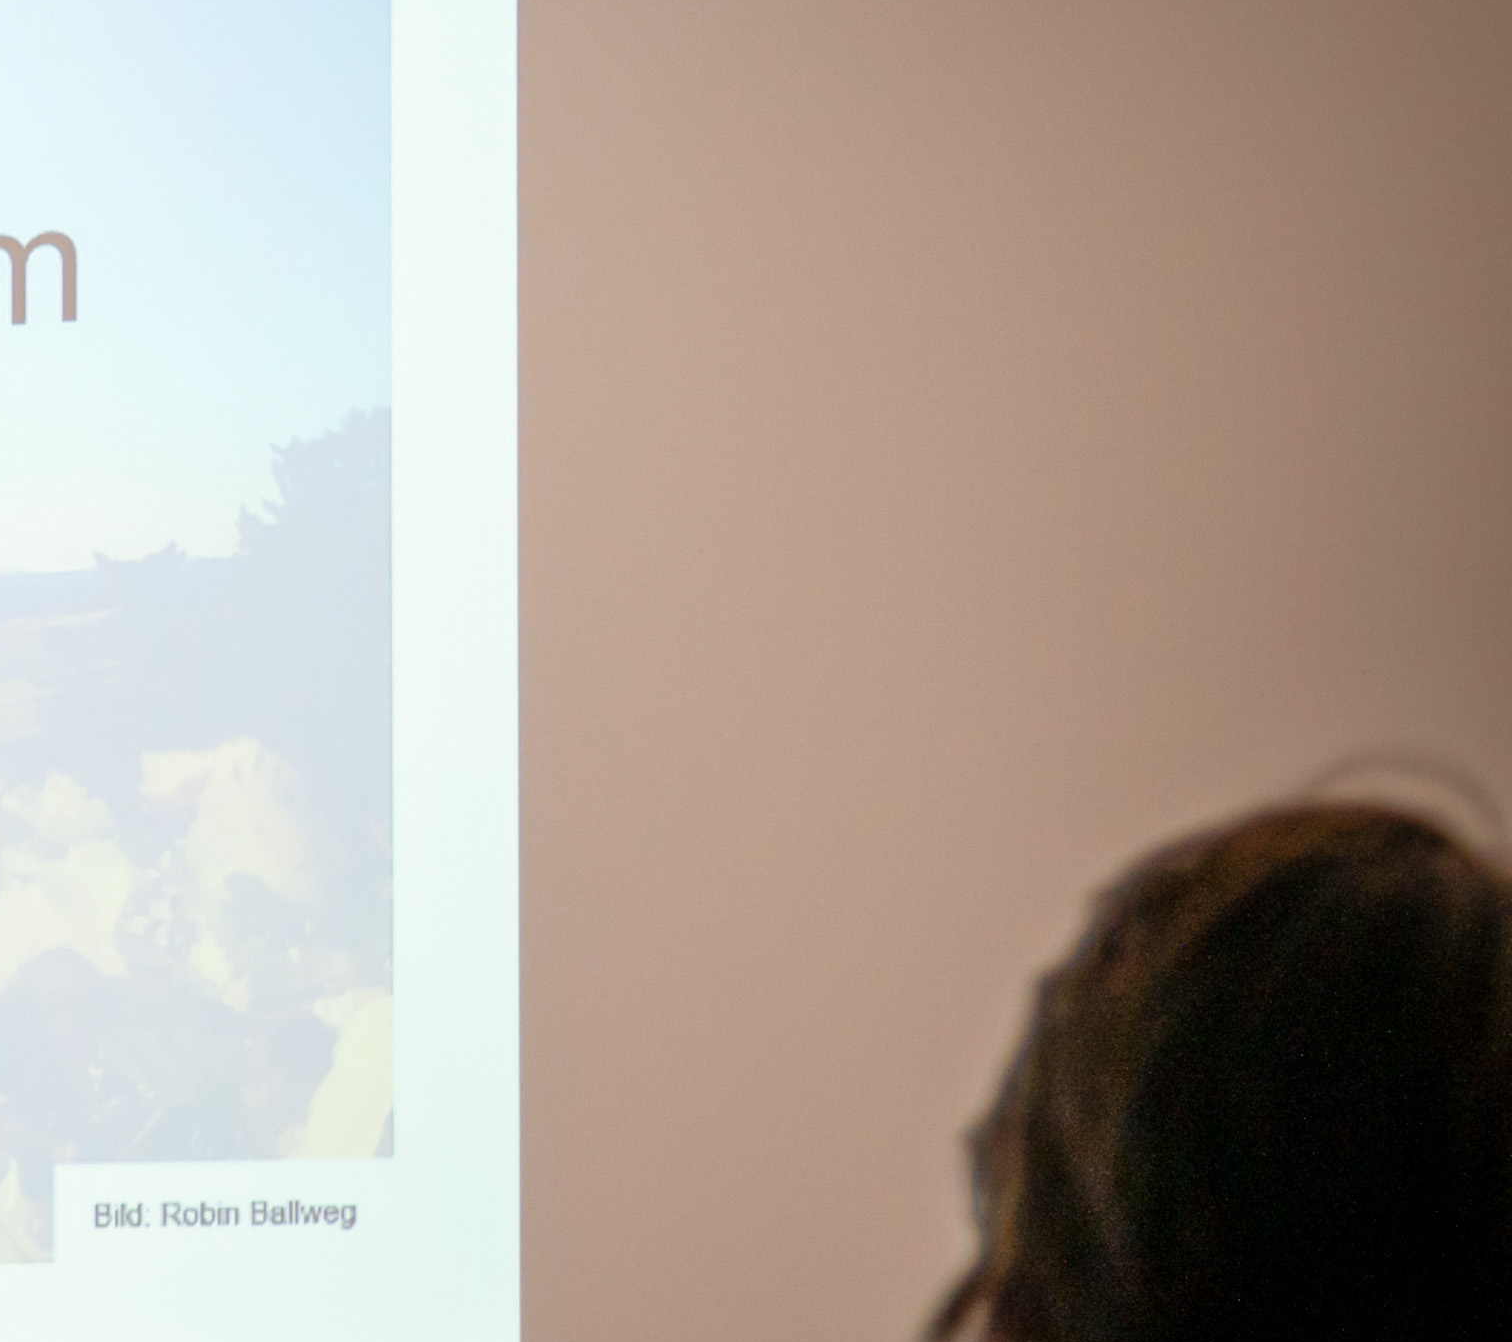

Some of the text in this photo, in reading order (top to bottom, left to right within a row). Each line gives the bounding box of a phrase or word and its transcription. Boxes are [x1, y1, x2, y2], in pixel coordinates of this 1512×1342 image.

[94, 1199, 358, 1230] Bild: Robin Ballweg
